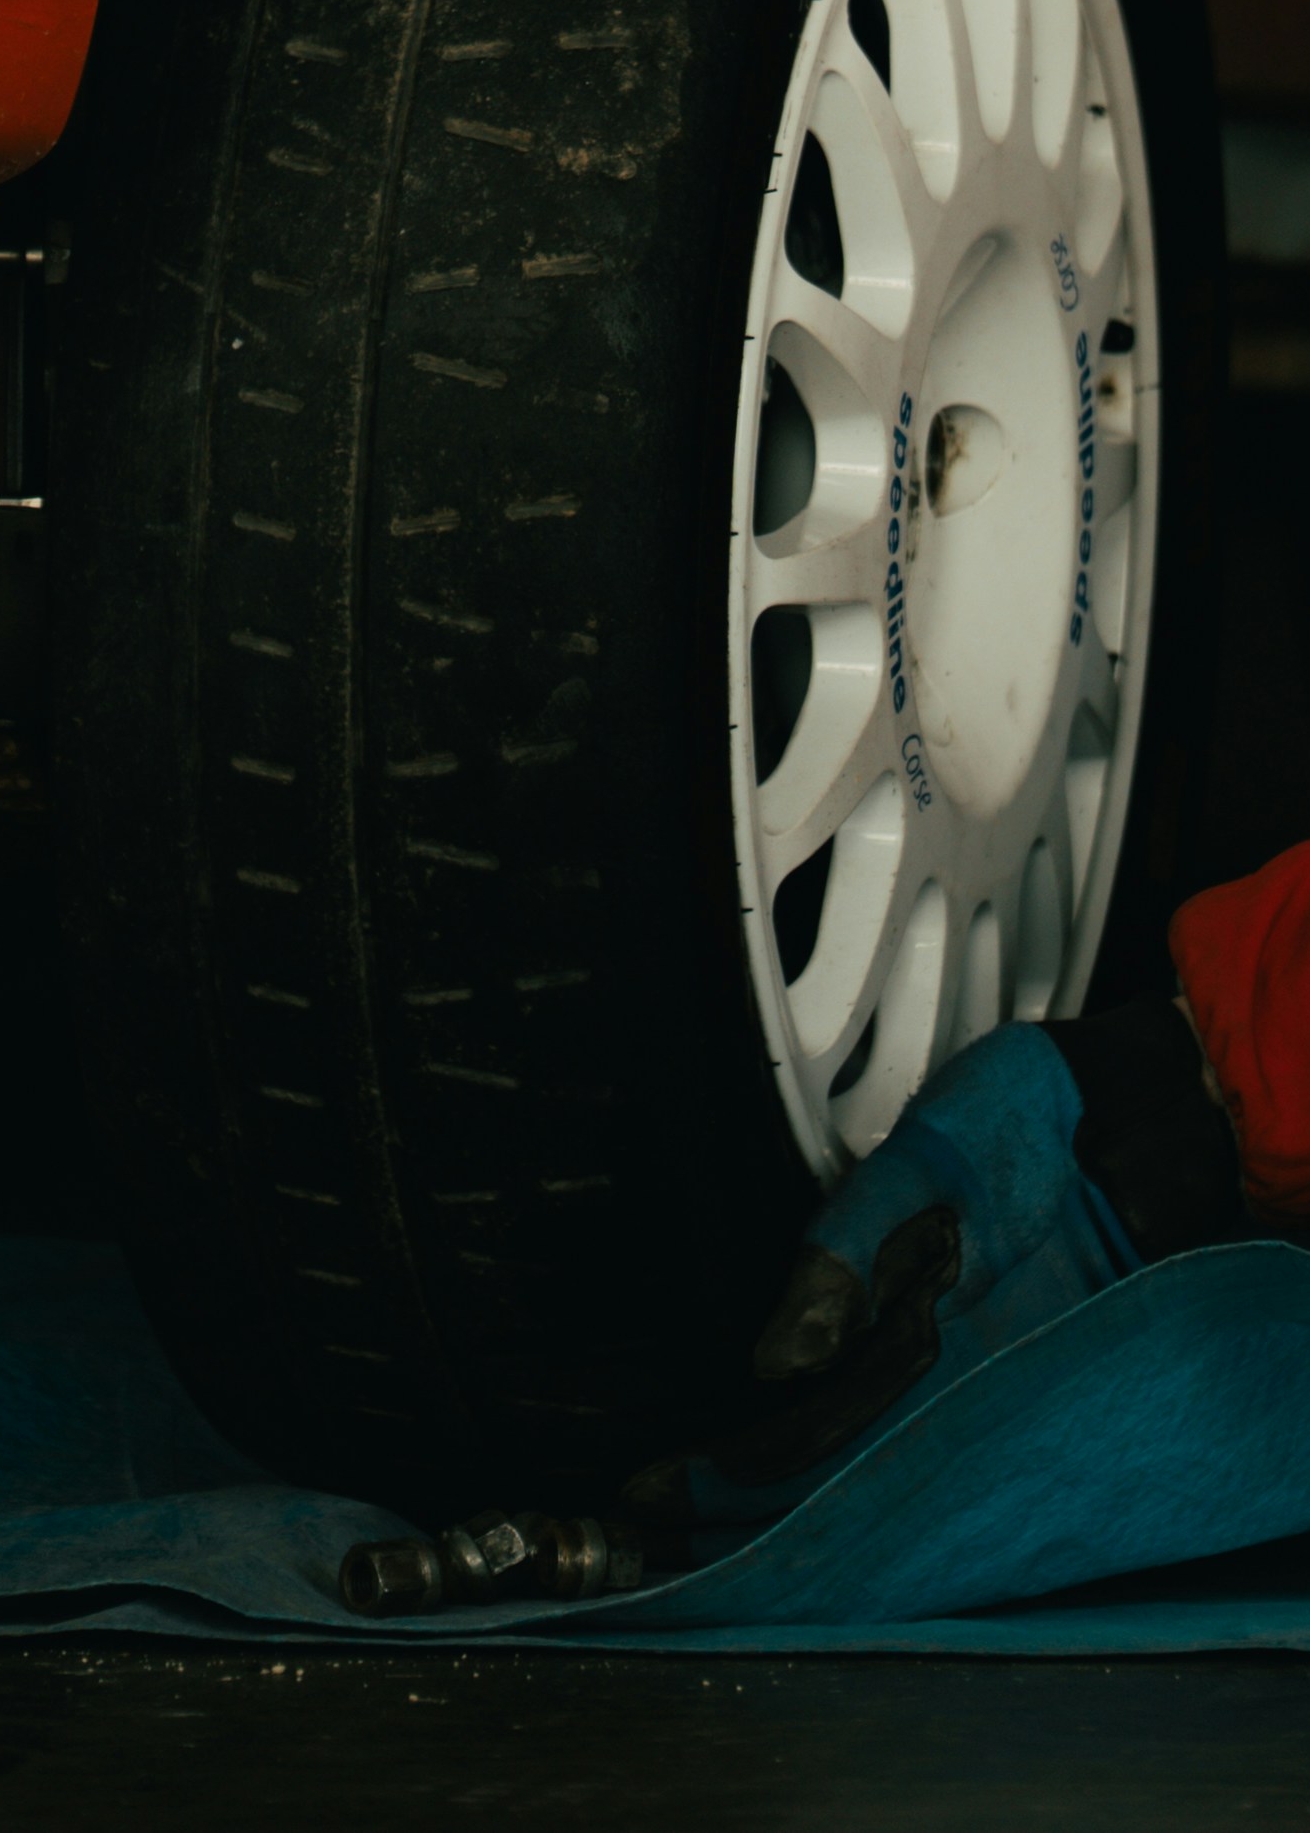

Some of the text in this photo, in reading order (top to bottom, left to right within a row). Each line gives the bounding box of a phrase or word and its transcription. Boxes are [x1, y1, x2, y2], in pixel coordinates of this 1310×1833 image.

[883, 391, 912, 715] speedline
[901, 733, 932, 813] Corse
[1070, 330, 1096, 648] speedline
